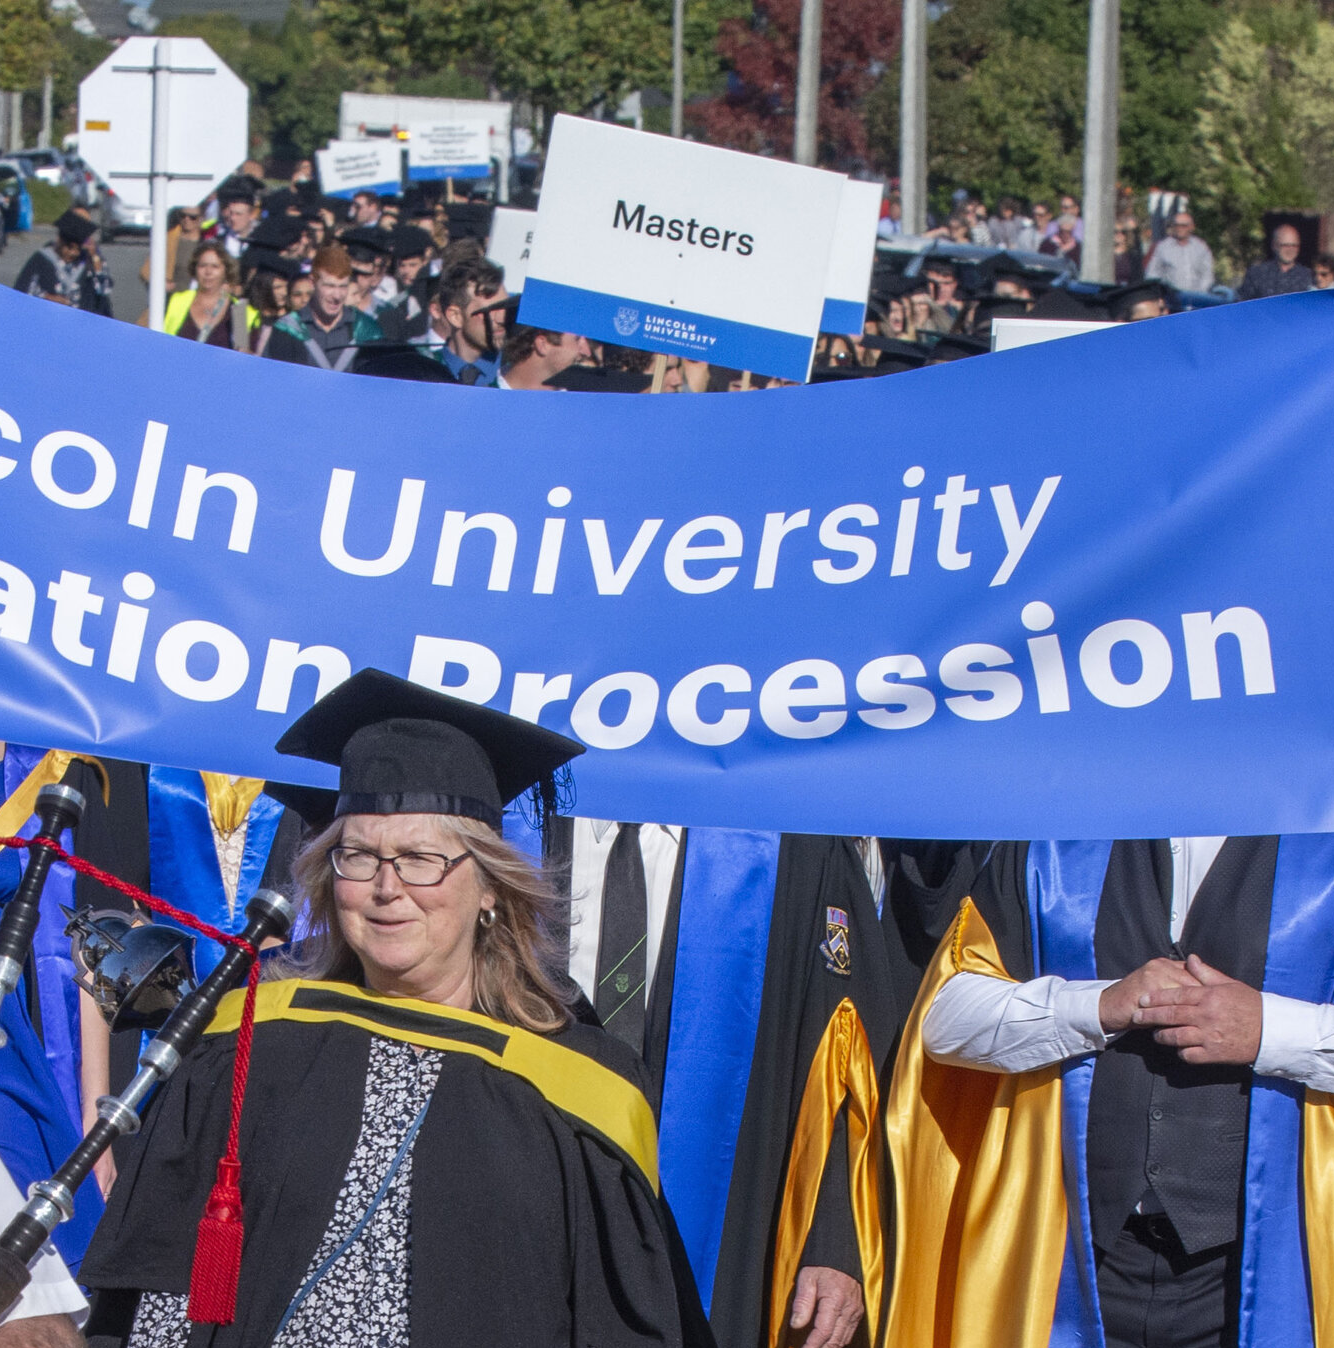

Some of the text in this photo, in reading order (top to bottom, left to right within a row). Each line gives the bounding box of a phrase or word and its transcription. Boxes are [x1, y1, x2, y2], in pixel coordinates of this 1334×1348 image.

[613, 199, 754, 256] Masters
[644, 323, 717, 345] UNIVERSITY
[645, 314, 696, 332] LINCOLN
[319, 465, 1062, 596] University
[405, 601, 1276, 751] Procession
